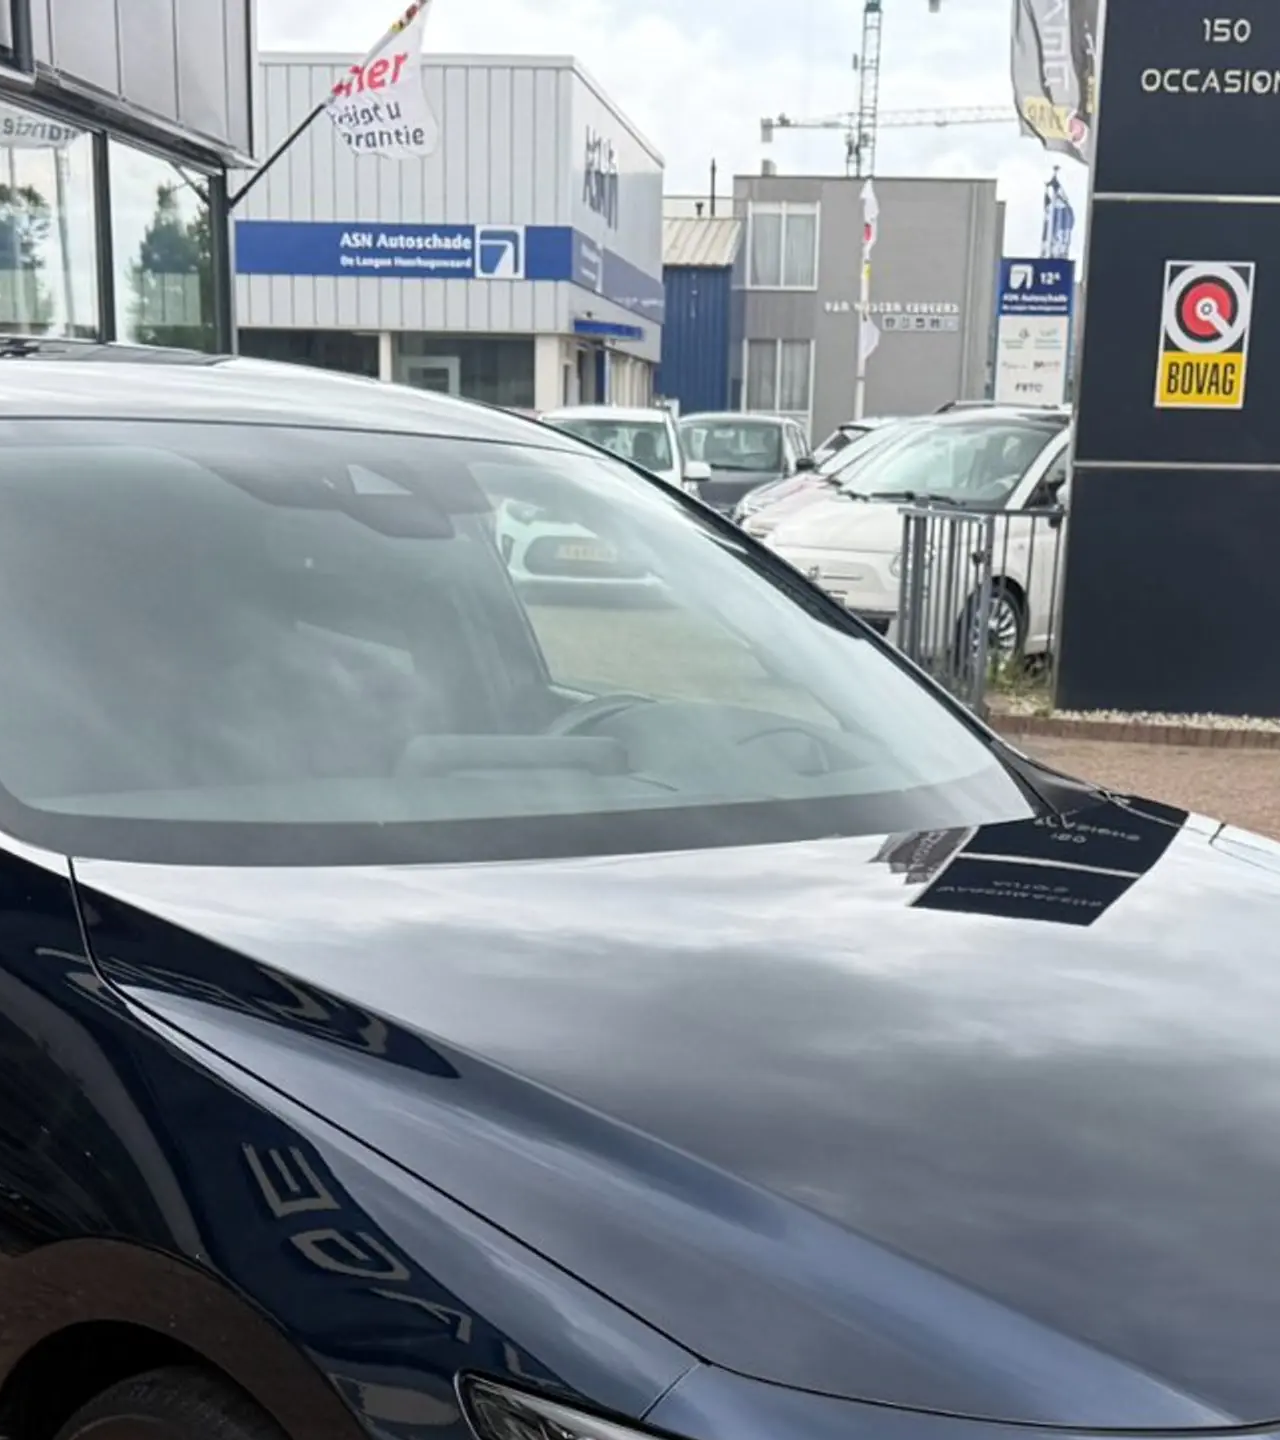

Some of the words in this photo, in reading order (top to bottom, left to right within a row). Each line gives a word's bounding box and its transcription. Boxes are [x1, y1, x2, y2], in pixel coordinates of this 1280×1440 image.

[1203, 17, 1251, 43] 150
[340, 232, 372, 249] ASN
[376, 232, 472, 249] Autoschade
[1166, 361, 1236, 396] BOVAG
